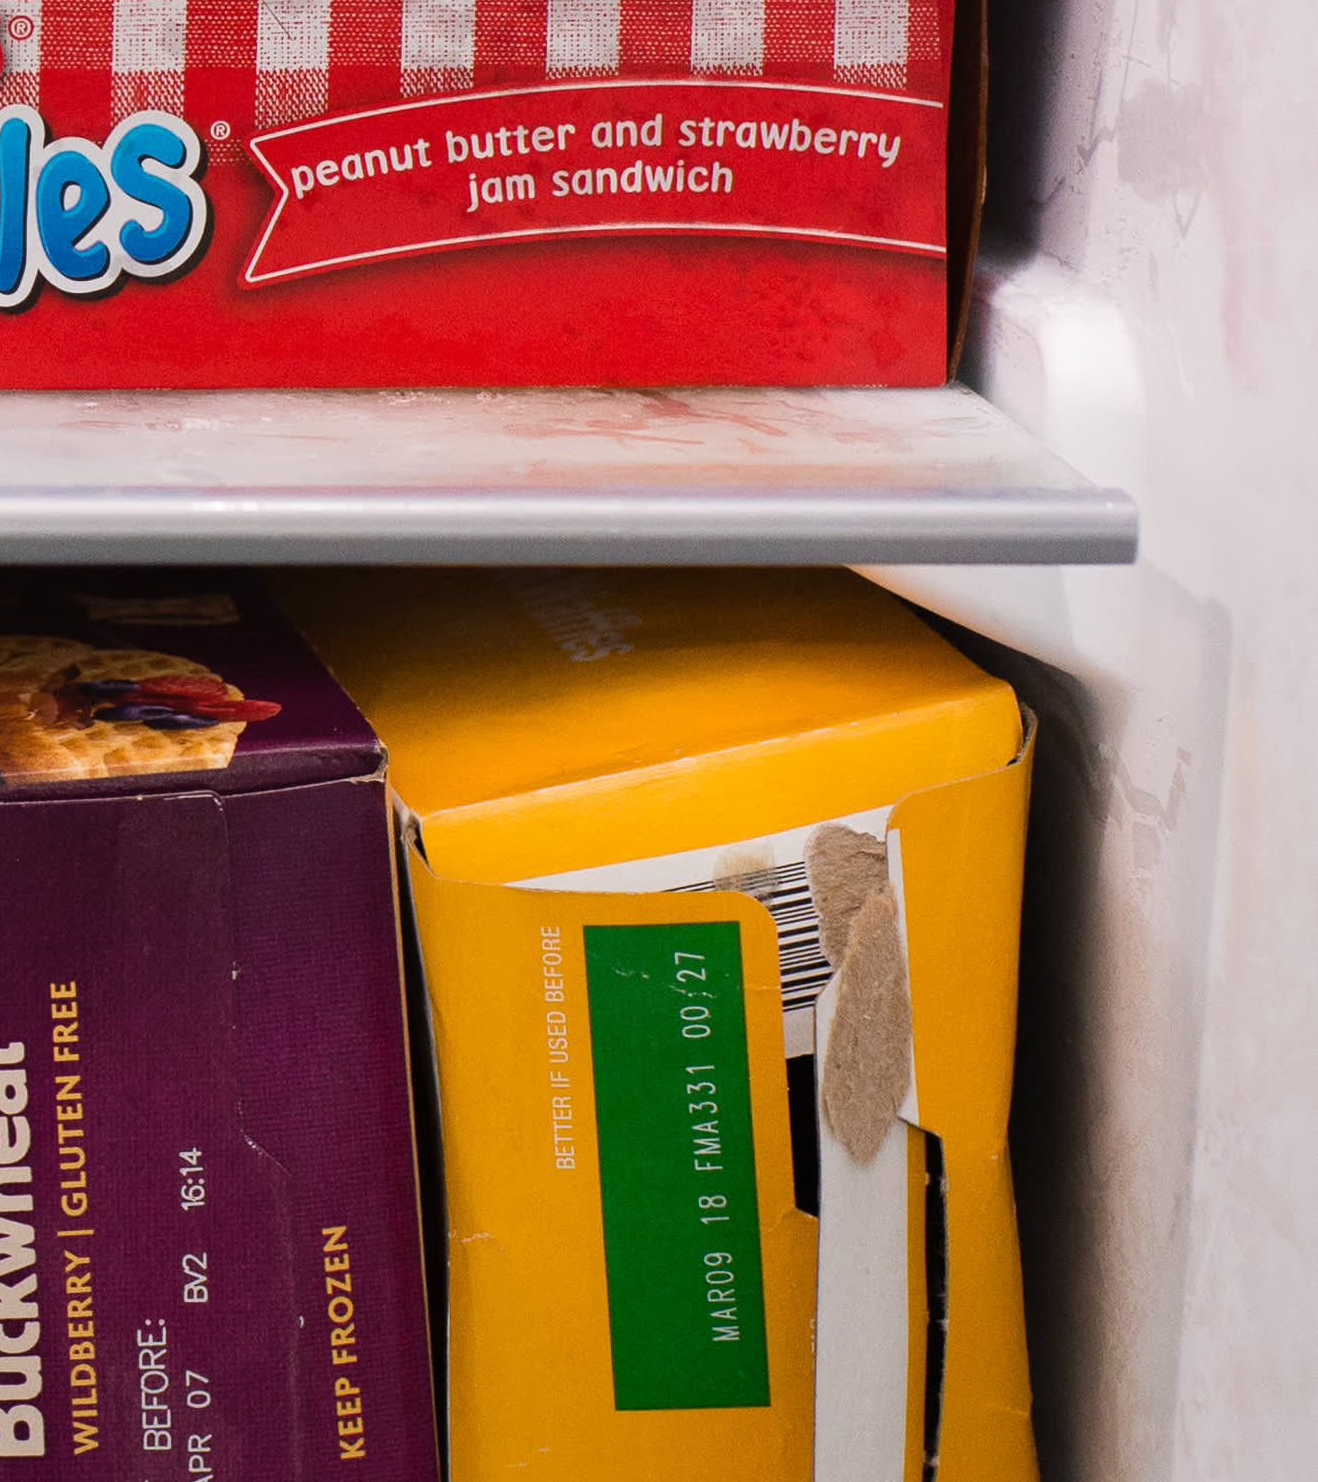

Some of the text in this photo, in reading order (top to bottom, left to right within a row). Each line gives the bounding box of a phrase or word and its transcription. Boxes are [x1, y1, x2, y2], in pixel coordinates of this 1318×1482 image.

[290, 113, 901, 199] peanut butter and strawberry
[466, 158, 734, 214] jam sandwich
[539, 925, 577, 1173] BETTER IF USED BEFORE
[686, 1063, 726, 1175] FMA331
[50, 980, 100, 1456] WILDBERRY GLUTEN FREE
[178, 1147, 203, 1212] 16:14
[698, 1193, 731, 1227] 18
[321, 1225, 367, 1461] KEEP FROZEN
[703, 1252, 741, 1344] MAR09
[136, 1317, 172, 1452] BEFORE:
[186, 1369, 211, 1410] 07
